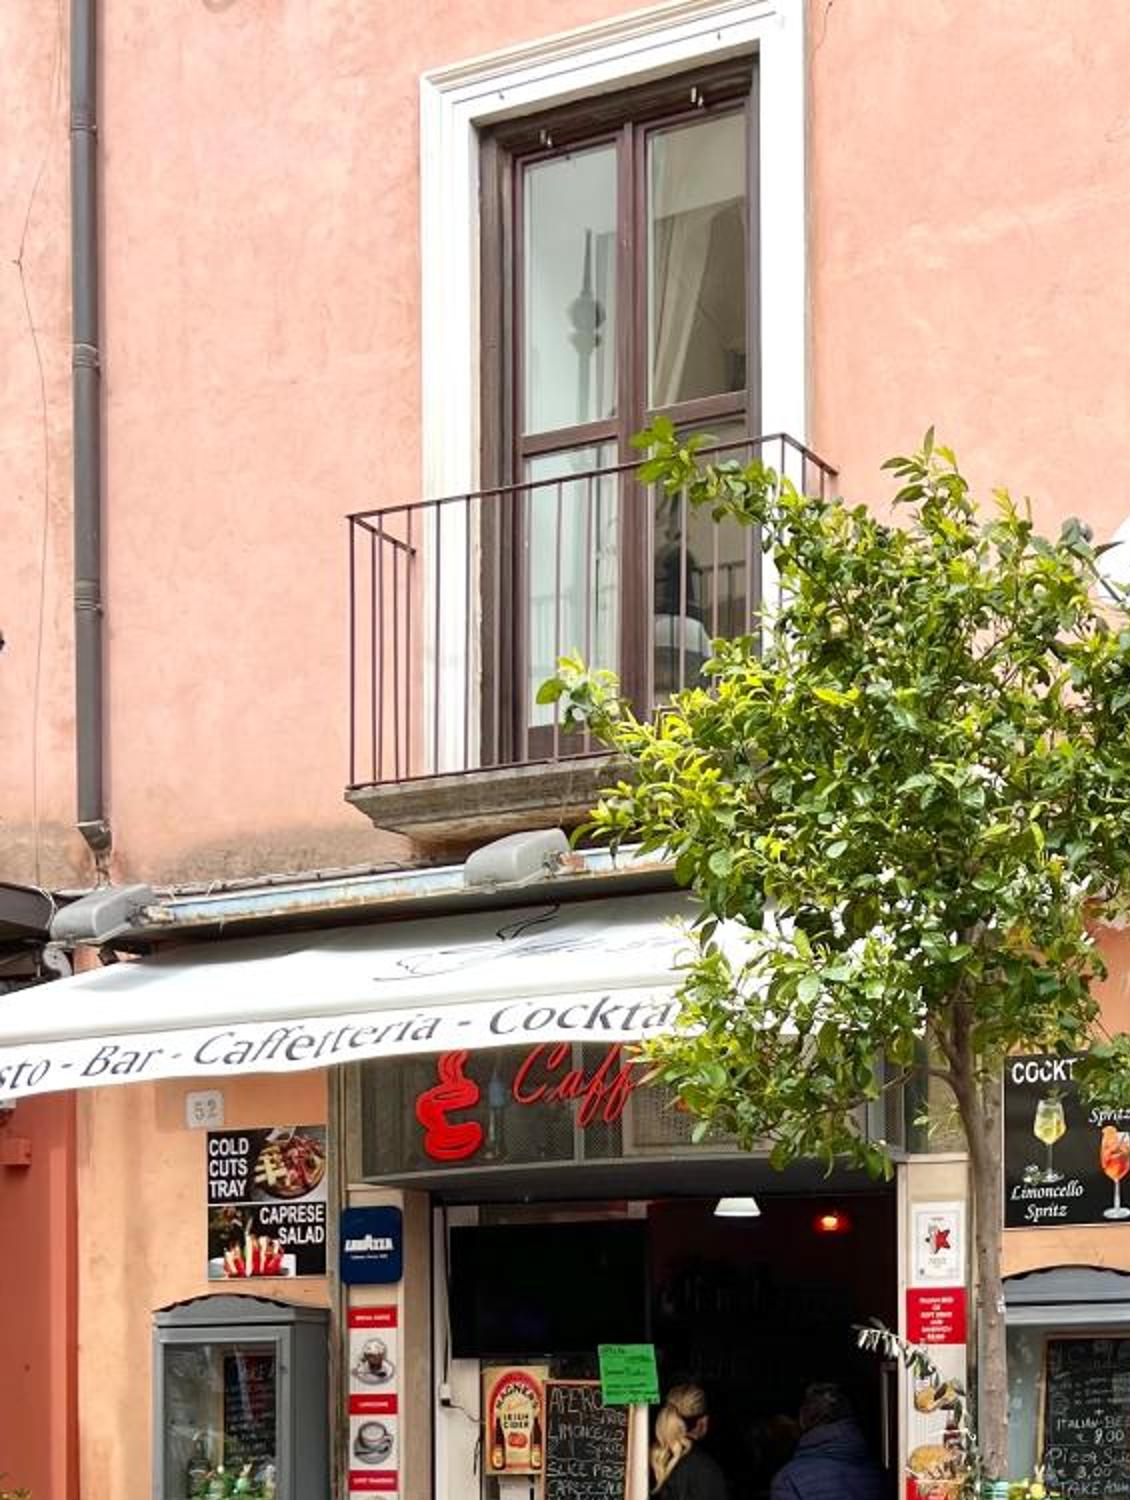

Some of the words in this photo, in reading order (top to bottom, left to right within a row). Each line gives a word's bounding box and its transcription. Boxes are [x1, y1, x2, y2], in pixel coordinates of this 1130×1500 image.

[80, 1045, 164, 1078] Bar
[194, 1014, 443, 1066] Caffetteria
[489, 996, 674, 1036] Cockta
[512, 1041, 638, 1128] Caff
[193, 1099, 218, 1121] 52
[209, 1137, 249, 1157] COLD
[209, 1158, 248, 1177] CUTS
[209, 1179, 247, 1198] TRAY
[1011, 1179, 1084, 1200] Limoncello
[259, 1204, 325, 1225] CAPRESE
[1024, 1203, 1068, 1222] Spritz
[278, 1225, 325, 1244] SALAD
